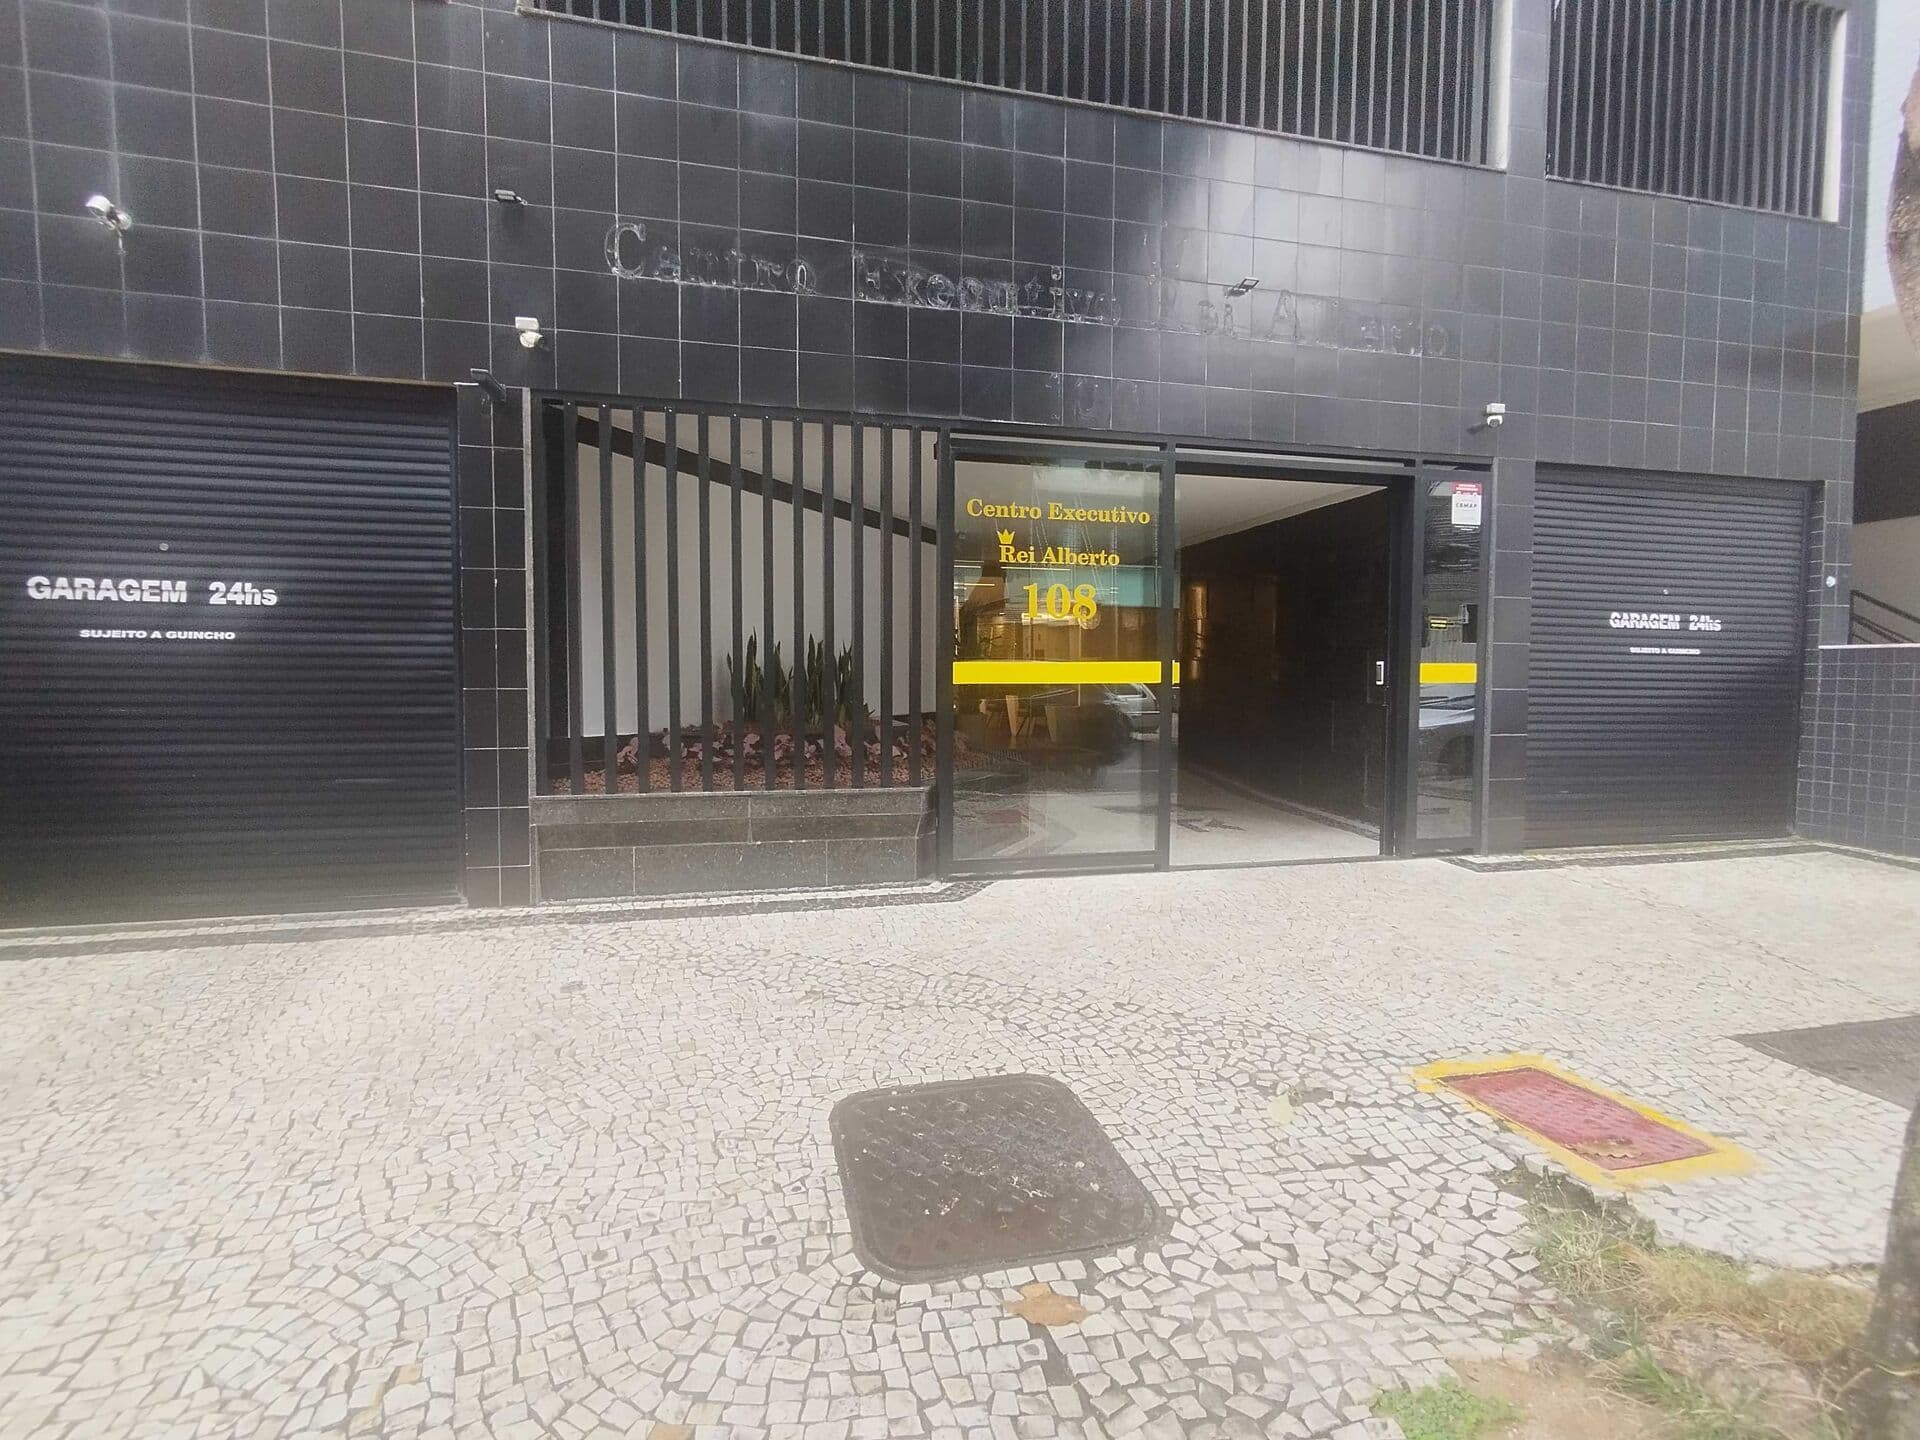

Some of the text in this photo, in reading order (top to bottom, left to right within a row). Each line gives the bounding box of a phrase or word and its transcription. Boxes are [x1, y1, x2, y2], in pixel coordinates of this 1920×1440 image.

[966, 498, 1151, 524] Centro Executivo
[999, 545, 1120, 566] Rei Alberto
[26, 575, 279, 606] GARAGEM 24hs
[1023, 582, 1097, 621] 108
[1609, 612, 1722, 631] GARAGEM 24hs
[79, 629, 236, 640] SUJEITO A GUINCHO
